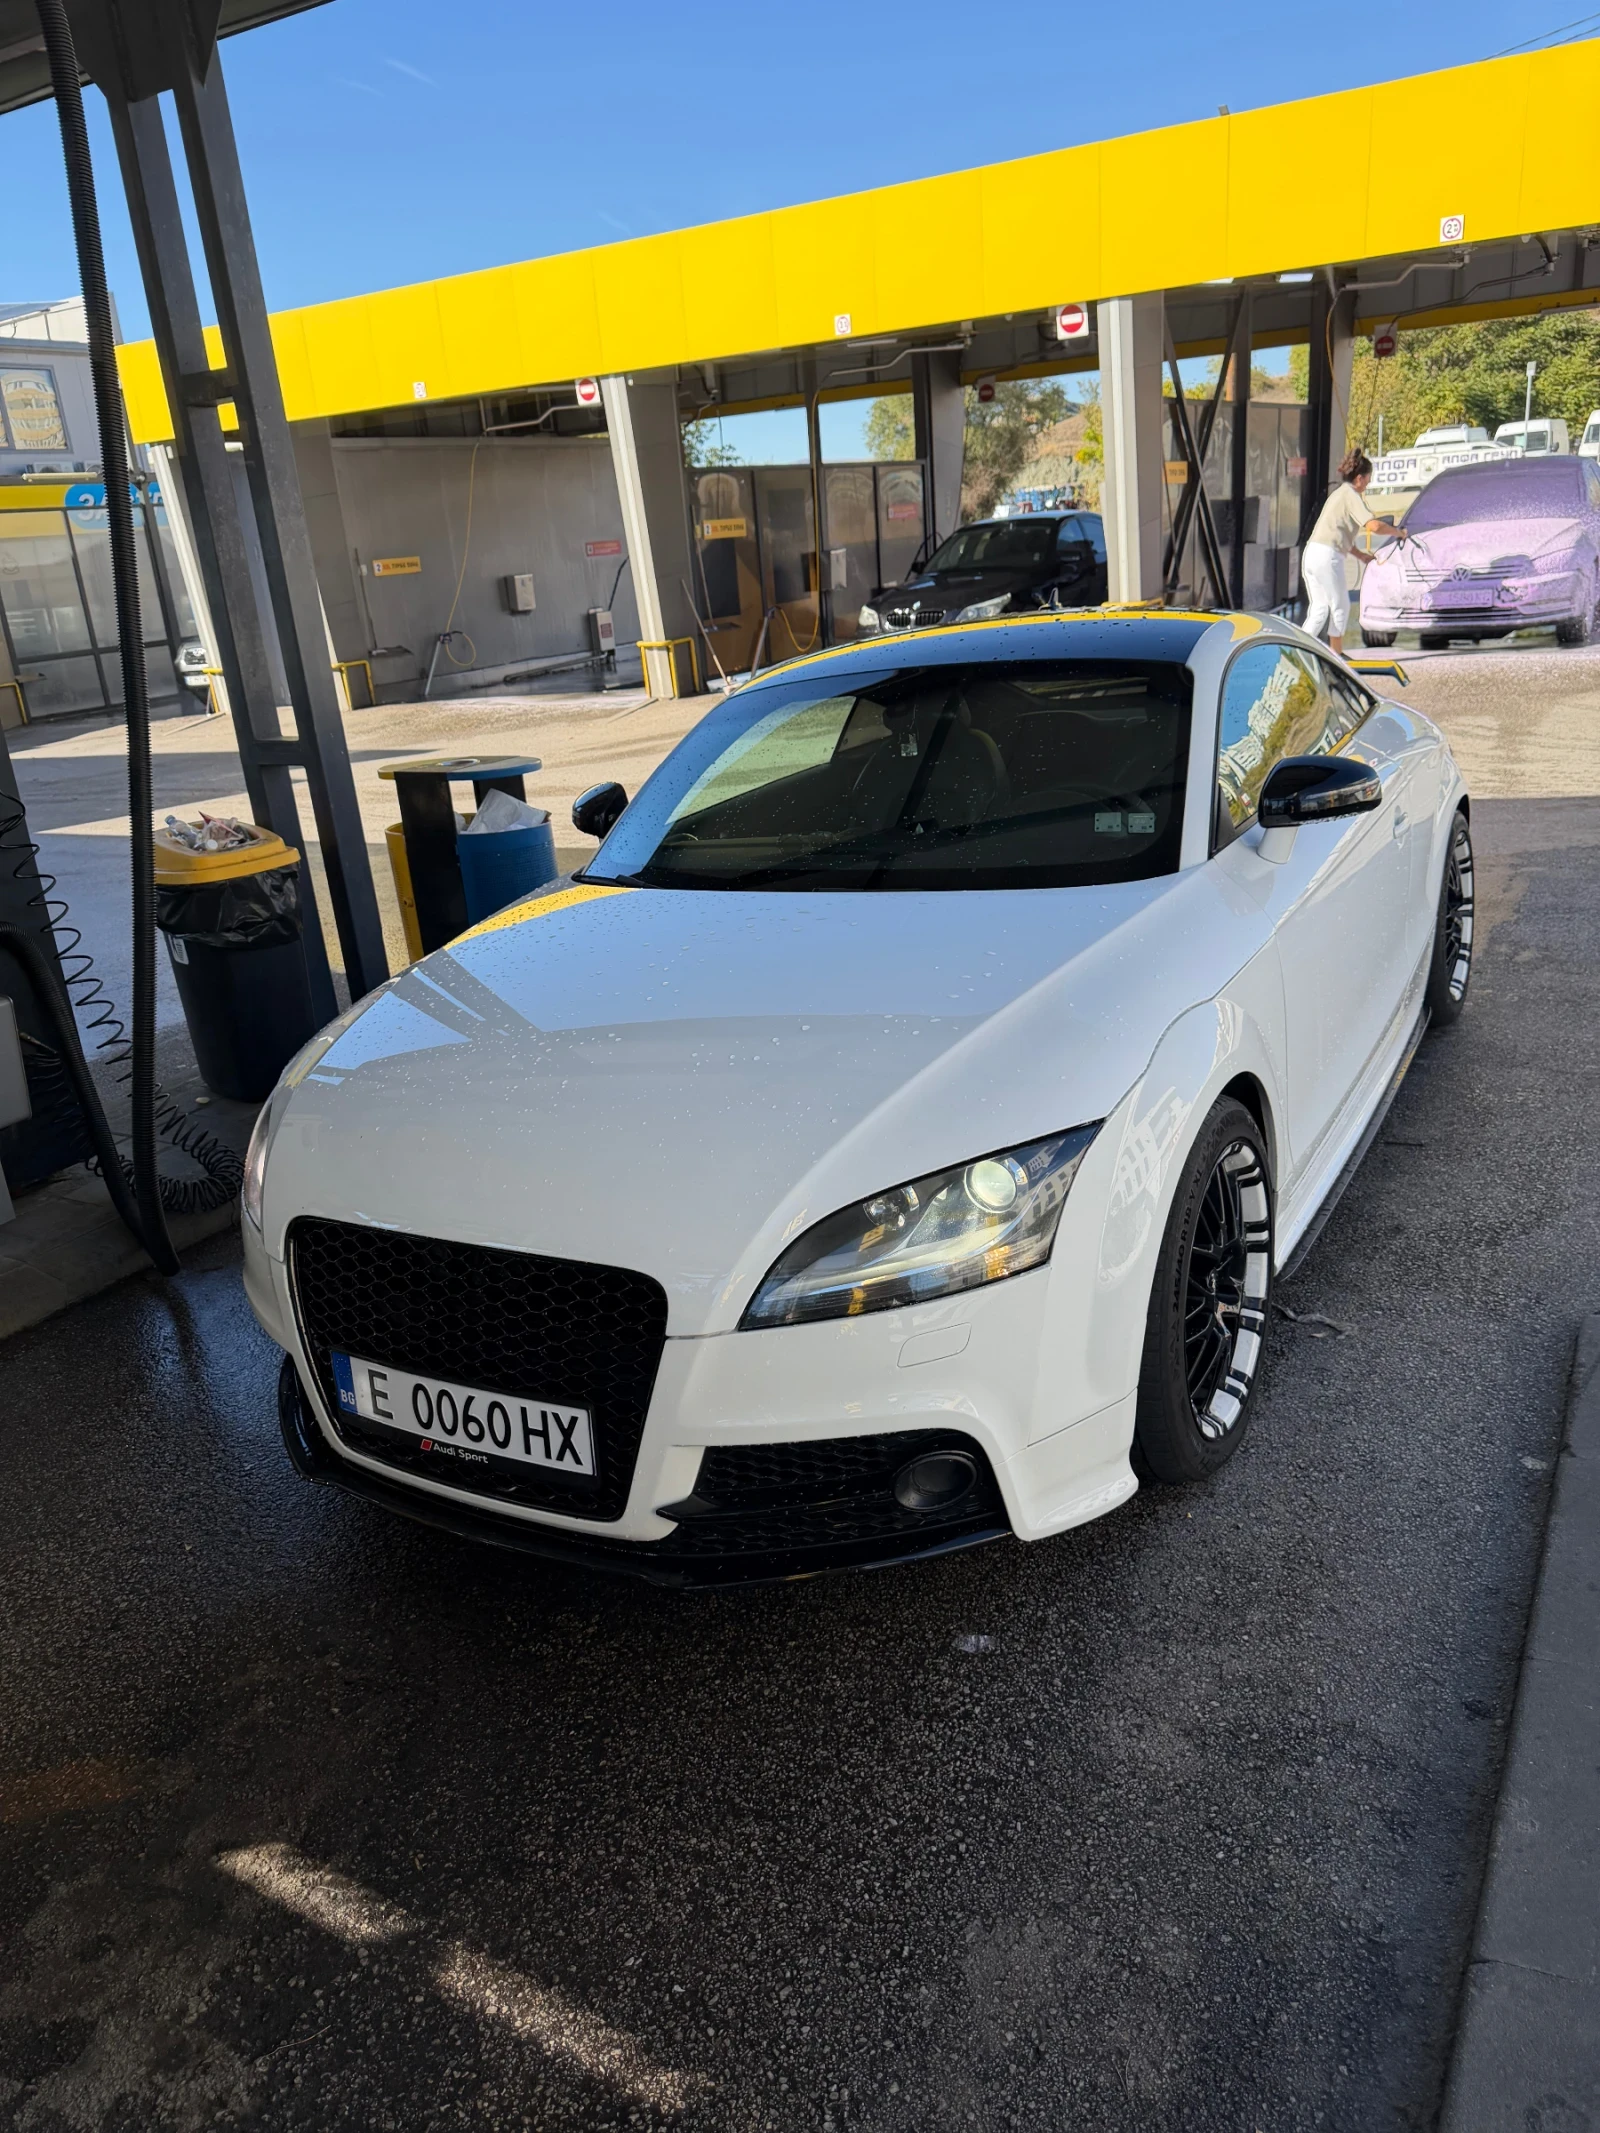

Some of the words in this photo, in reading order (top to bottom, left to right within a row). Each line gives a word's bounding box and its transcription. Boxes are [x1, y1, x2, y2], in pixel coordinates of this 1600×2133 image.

[340, 1389, 356, 1405] BG
[367, 1368, 394, 1420] E
[411, 1382, 512, 1450] 0060
[520, 1406, 584, 1466] HX
[433, 1442, 456, 1456] Audi
[458, 1449, 489, 1464] Sport
